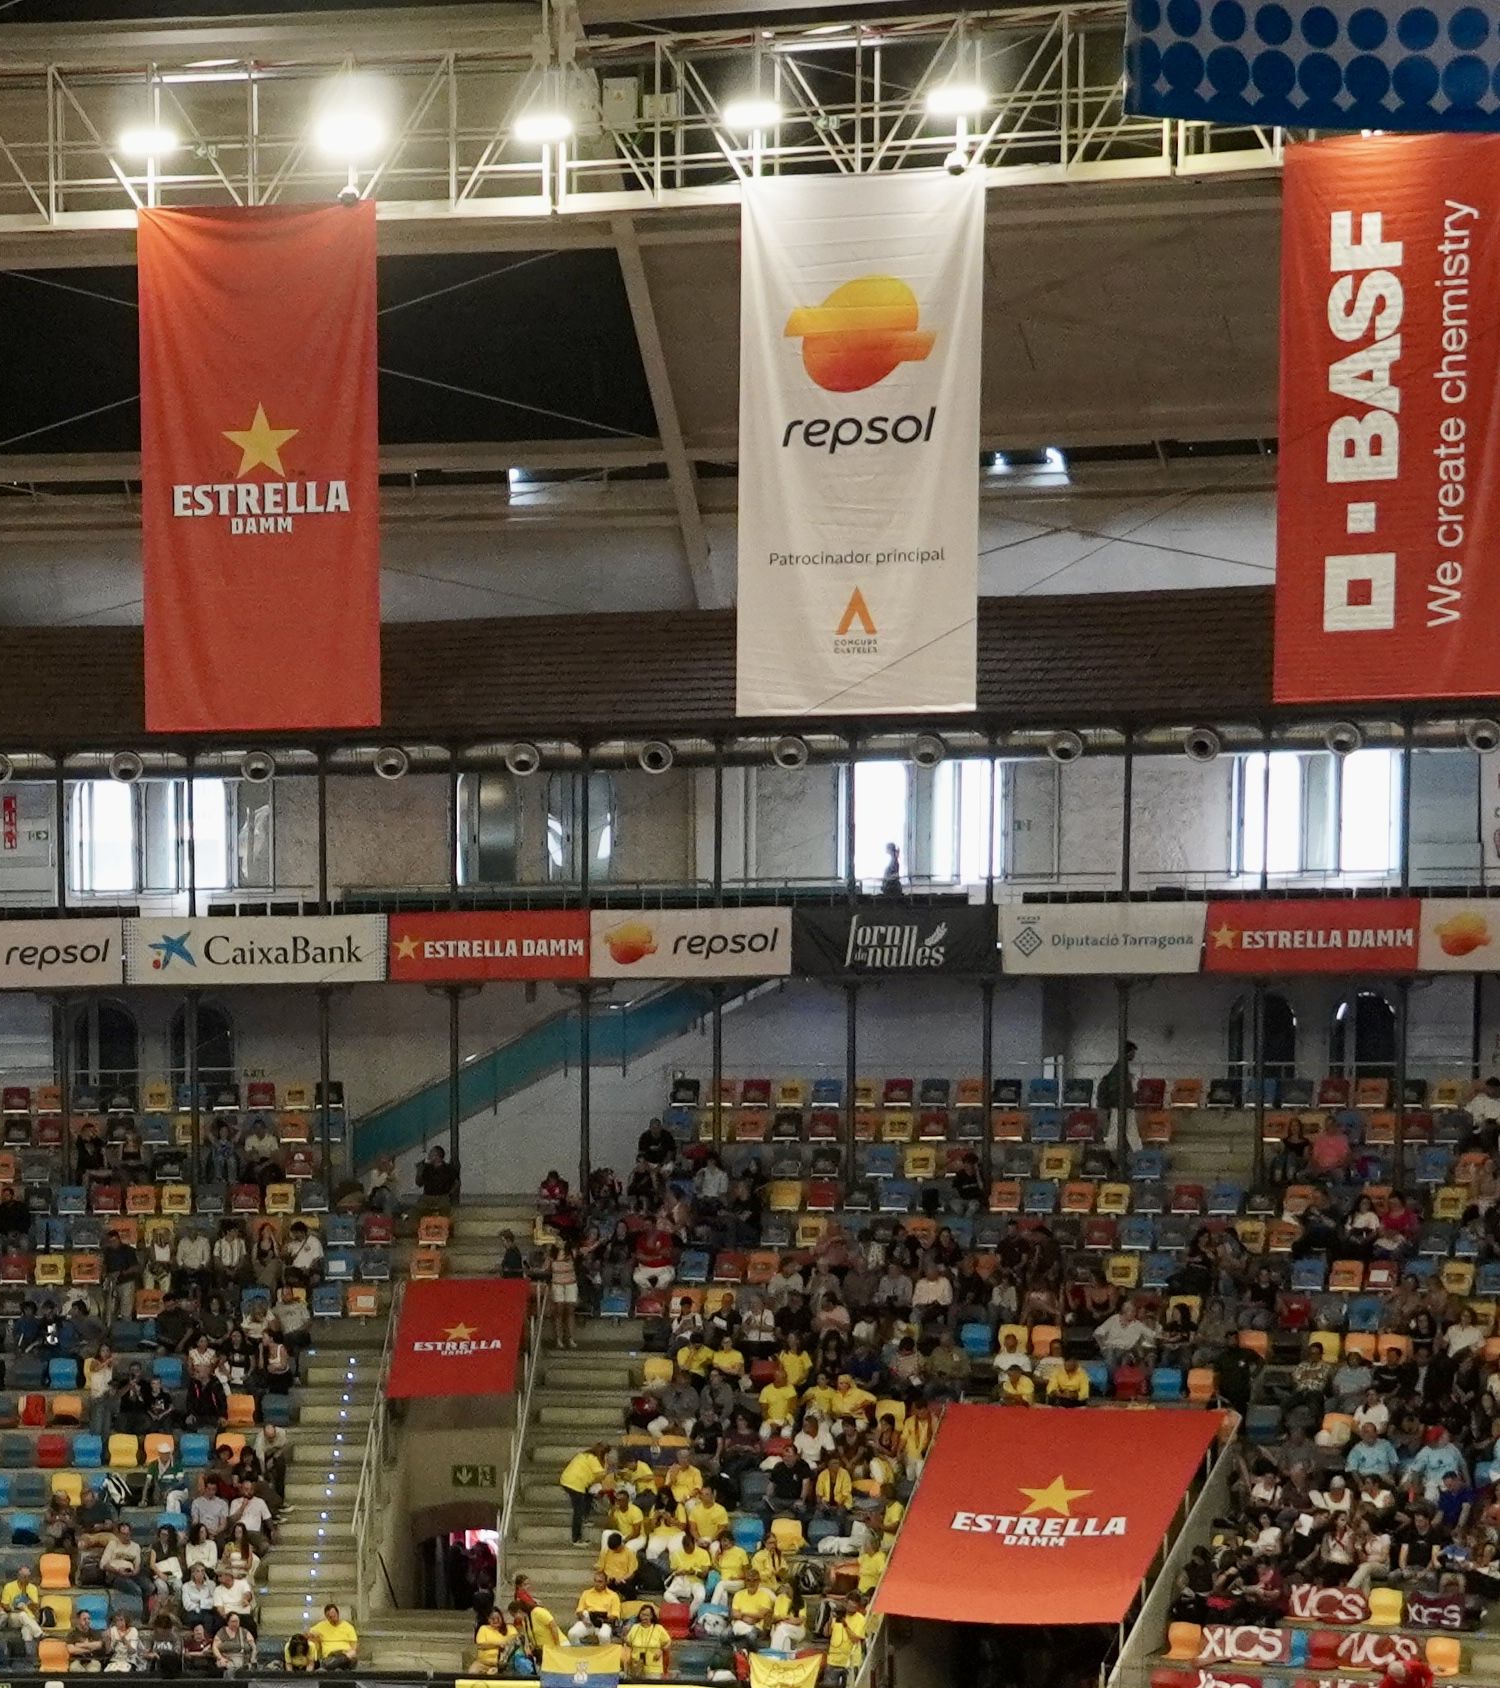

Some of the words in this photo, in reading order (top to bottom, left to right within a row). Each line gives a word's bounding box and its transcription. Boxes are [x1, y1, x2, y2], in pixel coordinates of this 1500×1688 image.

[1430, 198, 1481, 402] chemistry
[1326, 209, 1404, 484] BASF
[782, 406, 938, 455] repsol
[1426, 416, 1468, 546] create
[172, 480, 351, 518] ESTRELLA
[230, 516, 294, 535] DAMM
[768, 550, 873, 567] Patrocinador
[875, 547, 945, 567] principal
[1426, 562, 1463, 629] We
[5, 937, 110, 971] repsol
[203, 934, 364, 966] CaixaBank
[423, 938, 519, 960] ESTRELLA
[521, 937, 585, 958] DAMM
[672, 926, 779, 962] repsol
[1051, 931, 1119, 951] Diputació
[1121, 930, 1195, 951] Tarragona
[1241, 928, 1344, 951] ESTRELLA
[1346, 926, 1415, 949] DAMM
[413, 1339, 503, 1352] ESTRELLA
[950, 1510, 1128, 1538] ESTRELLA
[1002, 1535, 1067, 1548] DAMM
[1196, 1625, 1284, 1663] XICS
